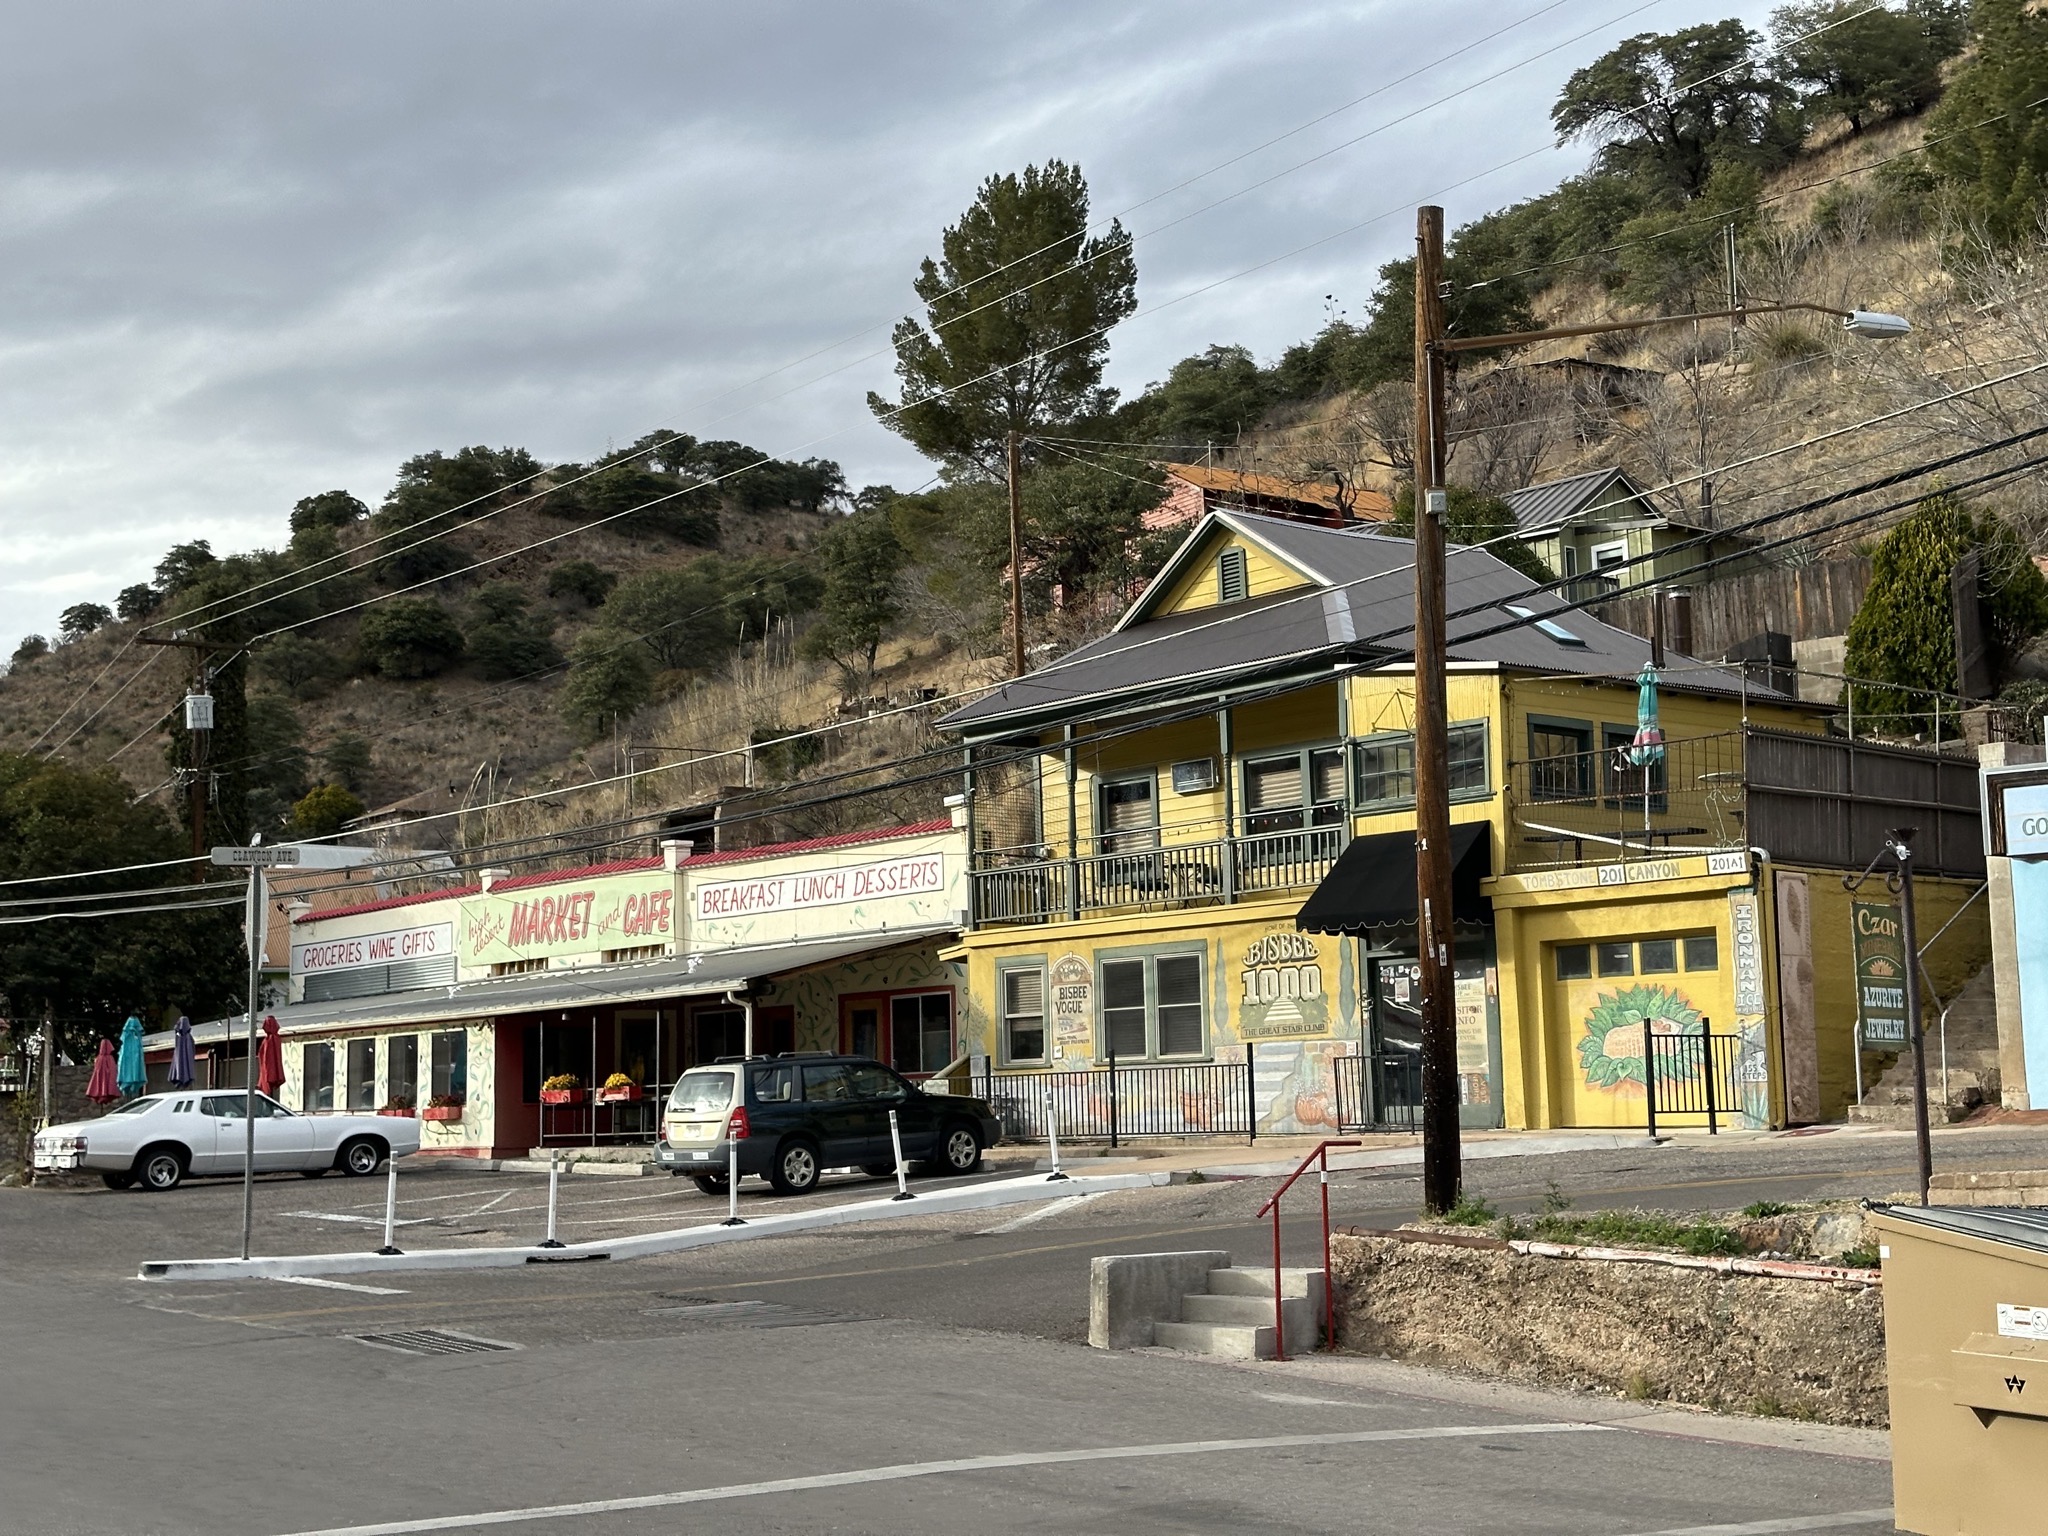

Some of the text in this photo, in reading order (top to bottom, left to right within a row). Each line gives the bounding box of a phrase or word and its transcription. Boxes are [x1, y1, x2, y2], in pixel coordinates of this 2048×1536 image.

[276, 851, 296, 862] AVE.
[702, 862, 938, 914] BREAKFAST LUNCH DESSERTS
[1522, 862, 1681, 889] TOMBSTONE 201 CANYON
[468, 906, 492, 941] high
[508, 889, 673, 948] MARKET and CAFE
[1858, 908, 1898, 938] Czar
[473, 913, 505, 956] desert
[303, 930, 436, 969] GROCERIES WINE GIFTS
[1242, 933, 1320, 968] BISBEE
[1735, 904, 1756, 993] IRONMAN
[1059, 986, 1088, 1000] BISBEE
[1241, 963, 1323, 1006] 1000
[1863, 986, 1904, 1008] AZURITE
[1055, 1000, 1083, 1014] VOGUE
[1737, 992, 1761, 1006] ICE
[1245, 1023, 1325, 1037] THE GREAT STAIR CLIMB
[1457, 1016, 1476, 1025] NFO
[1865, 1018, 1905, 1039] JEWELRY
[1742, 1072, 1767, 1080] STEPS
